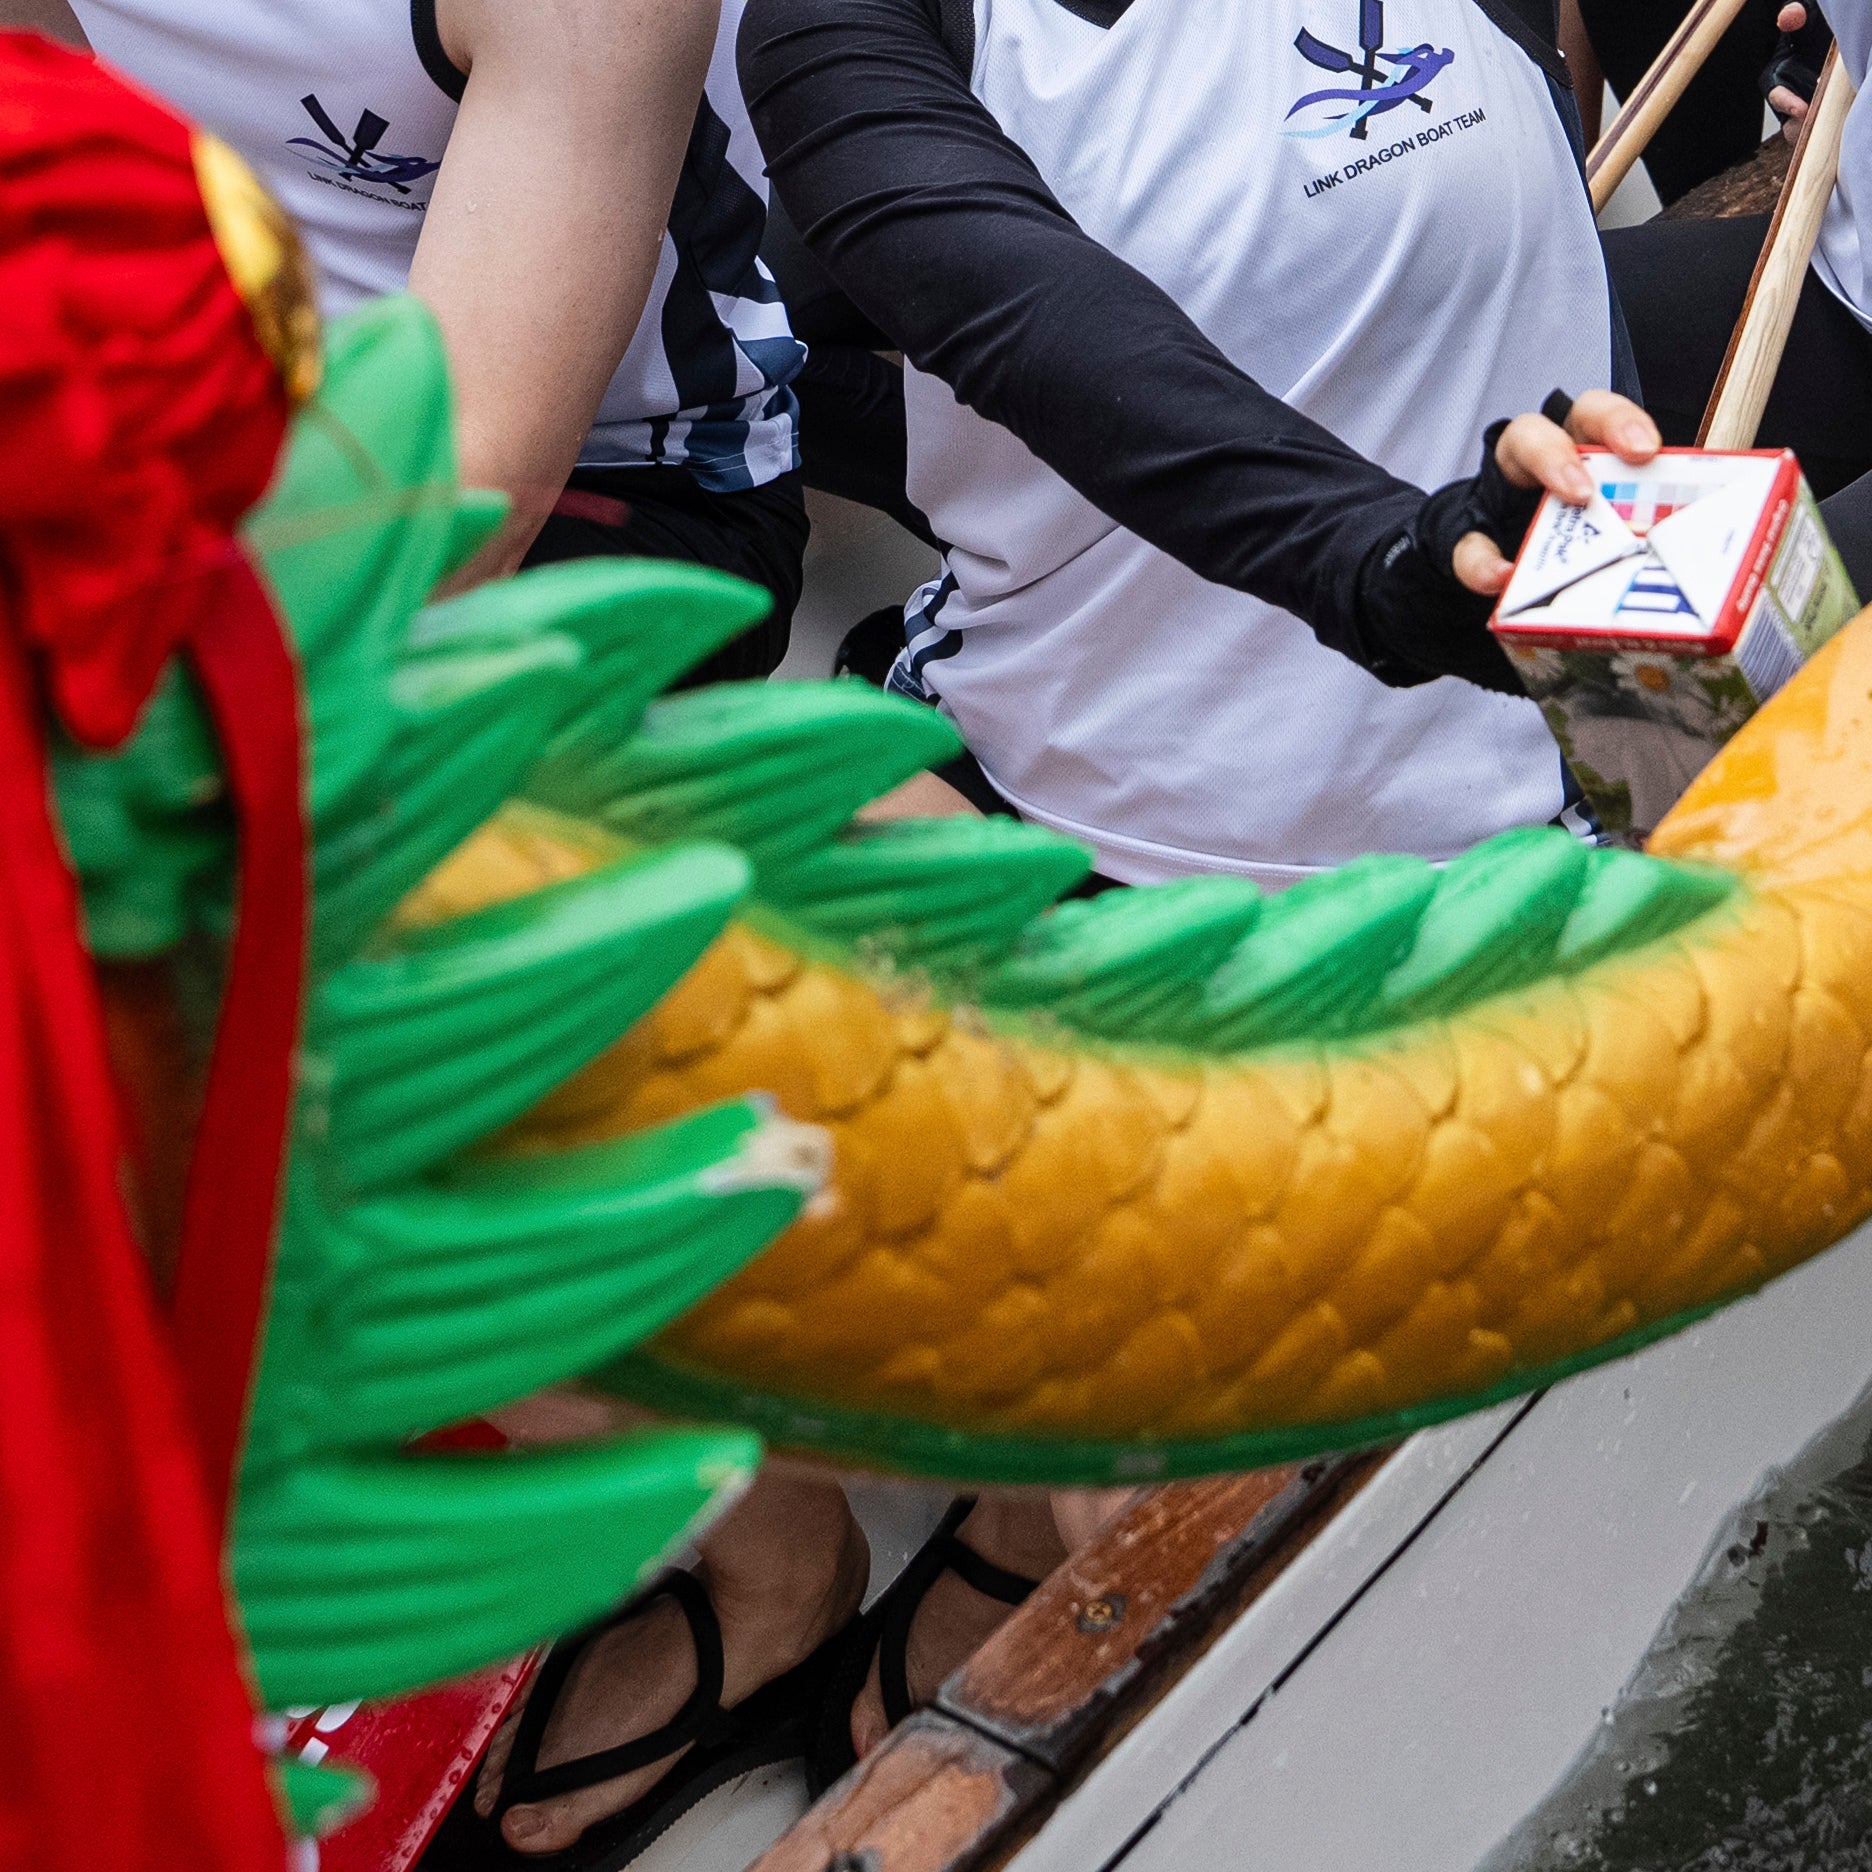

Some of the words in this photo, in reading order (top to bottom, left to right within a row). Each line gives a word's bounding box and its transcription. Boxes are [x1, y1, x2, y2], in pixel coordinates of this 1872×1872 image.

[1303, 170, 1344, 198] LINK
[1343, 137, 1416, 180] DRAGON
[1415, 121, 1454, 147] BOAT
[1453, 107, 1486, 131] TEAM
